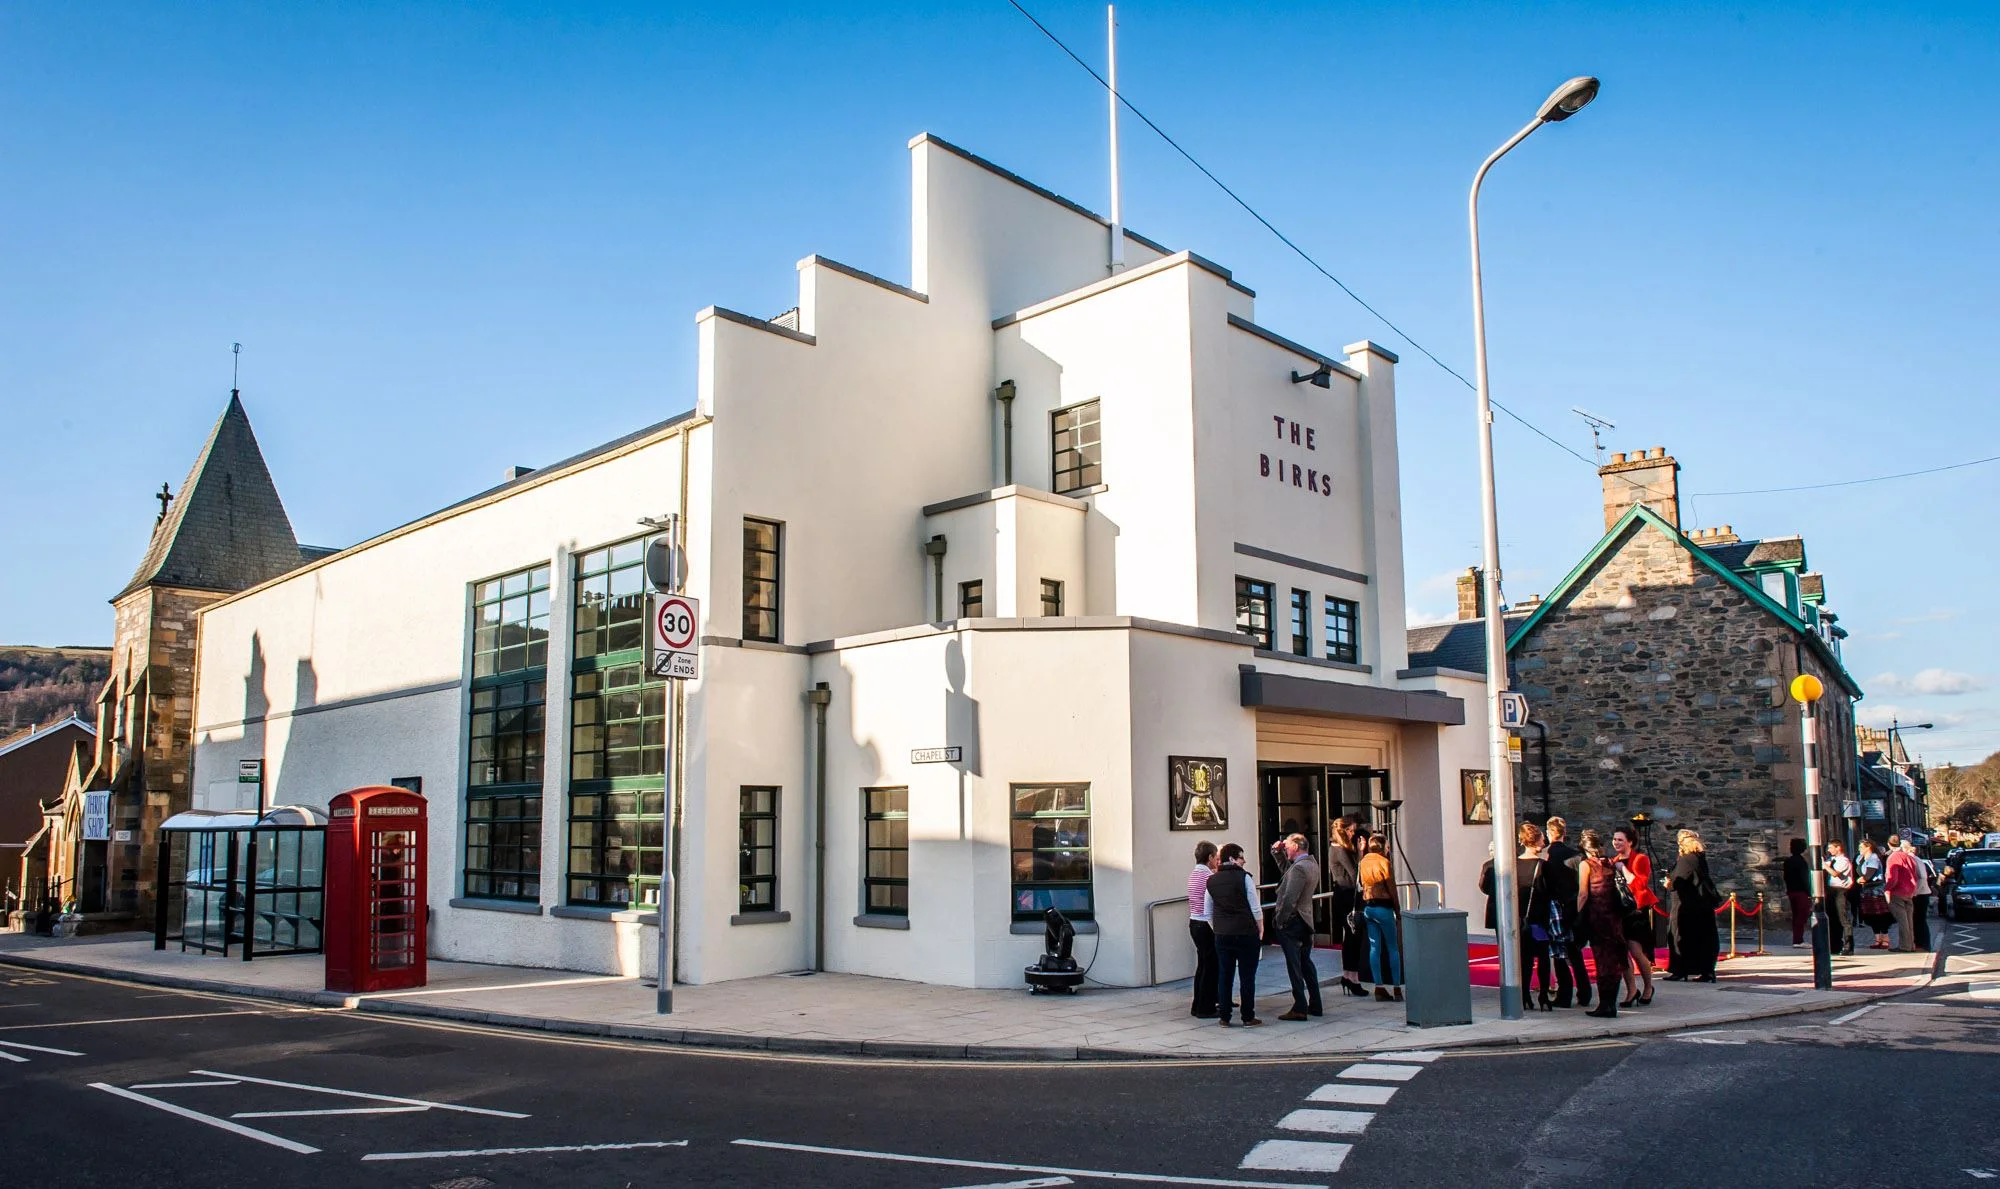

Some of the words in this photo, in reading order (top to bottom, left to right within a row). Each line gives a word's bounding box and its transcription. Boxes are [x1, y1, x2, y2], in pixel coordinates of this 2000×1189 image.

[1273, 415, 1316, 451] THE
[1260, 453, 1331, 497] BIRKS
[664, 613, 690, 635] 30
[673, 665, 695, 675] ENDS
[677, 656, 692, 665] Zone
[1505, 700, 1514, 721] P
[915, 750, 942, 761] CHAPEL
[87, 794, 107, 817] THRIFT
[370, 806, 419, 816] TELEPHONE
